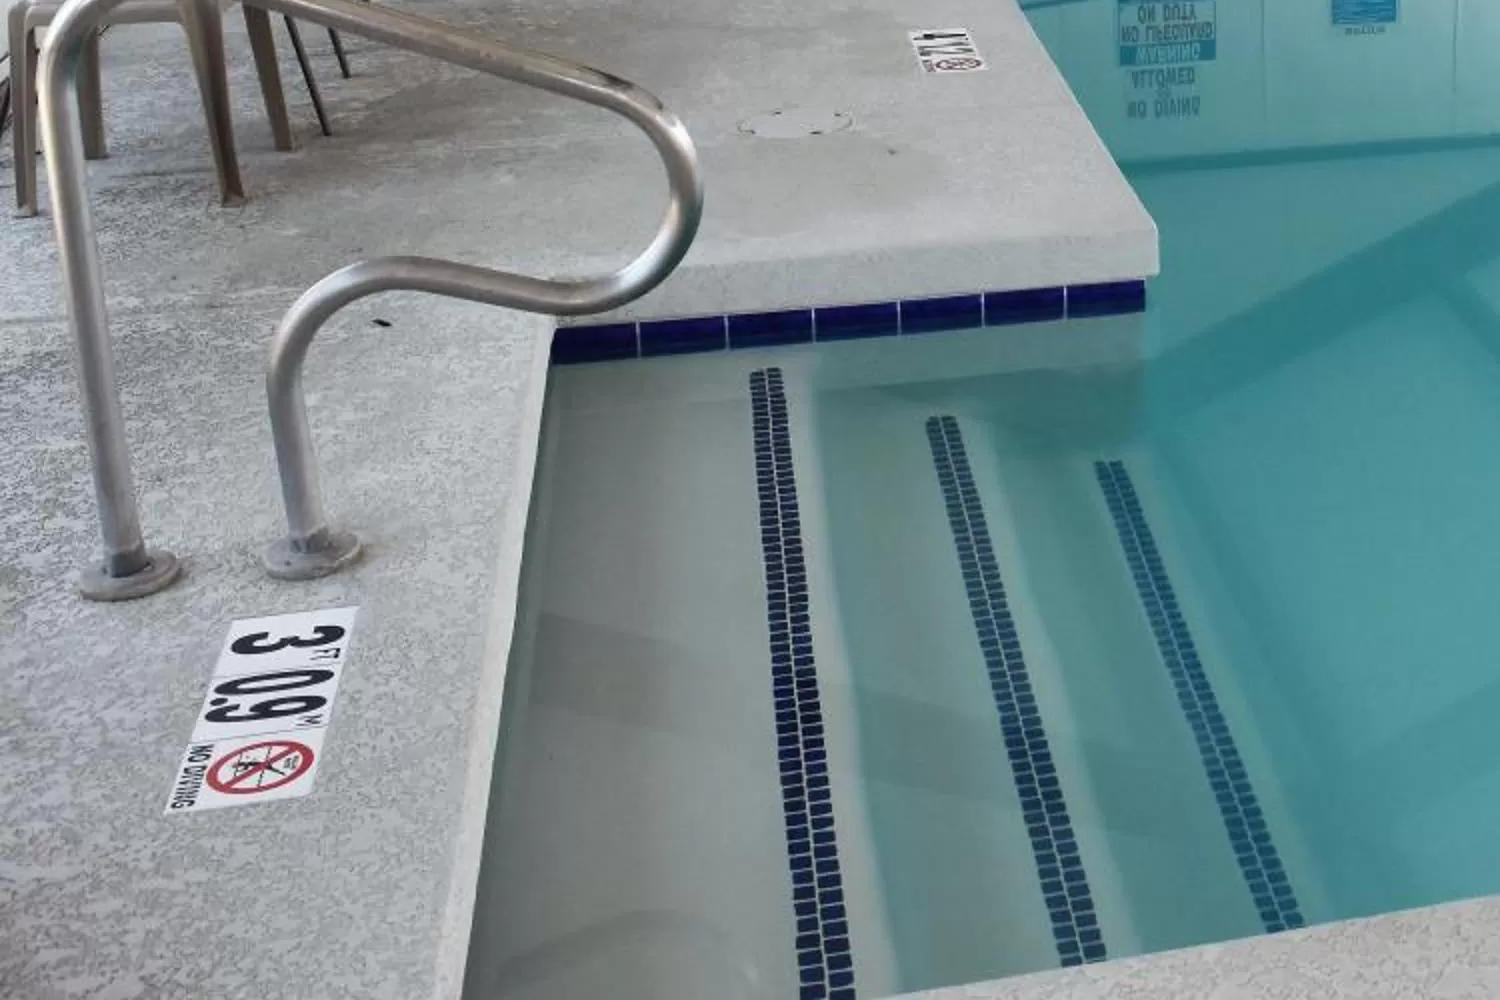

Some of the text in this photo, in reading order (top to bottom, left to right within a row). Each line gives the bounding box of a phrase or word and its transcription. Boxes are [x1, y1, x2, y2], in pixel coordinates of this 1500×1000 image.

[231, 625, 345, 654] 3
[205, 669, 335, 723] 0.9
[170, 744, 214, 809] NO DIVING
